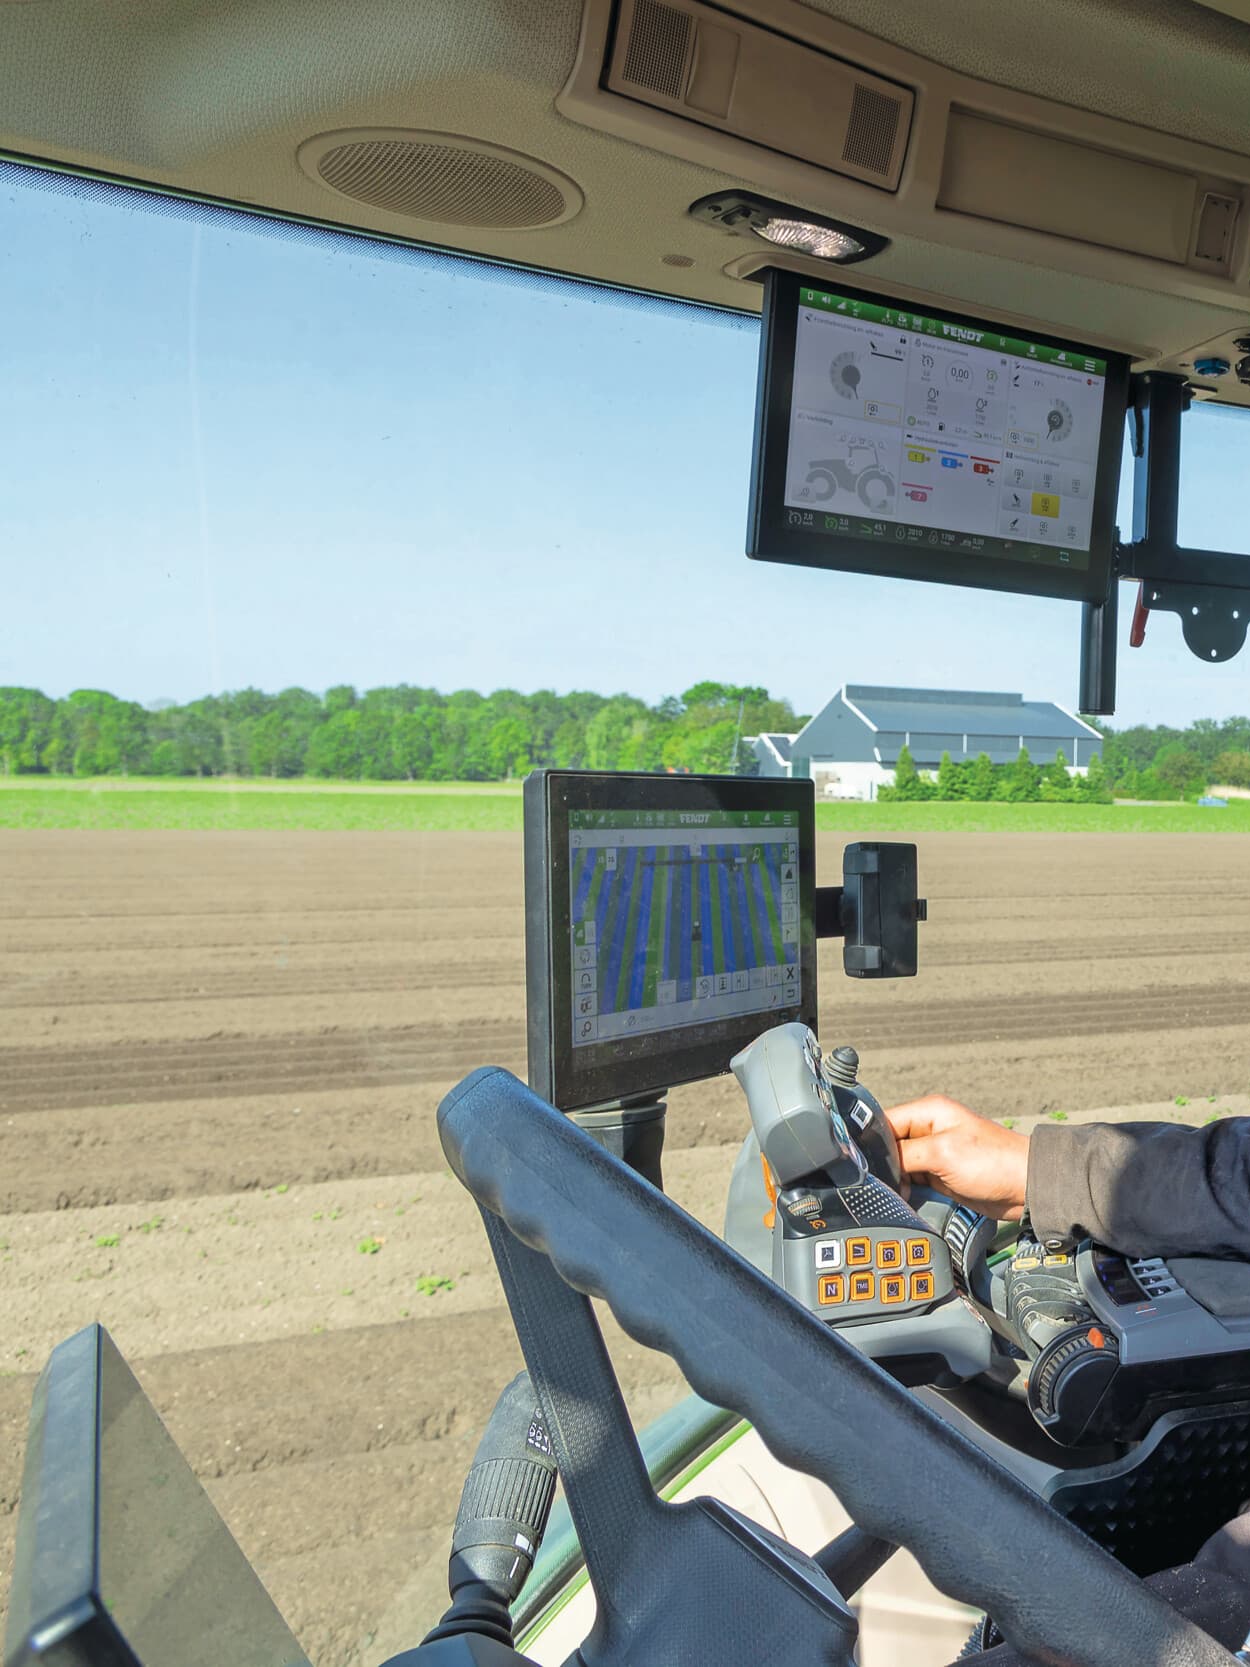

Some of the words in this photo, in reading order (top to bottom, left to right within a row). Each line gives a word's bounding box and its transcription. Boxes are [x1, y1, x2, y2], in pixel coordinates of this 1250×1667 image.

[943, 325, 985, 343] FENDT
[680, 813, 711, 824] FENDT
[827, 1284, 837, 1296] N
